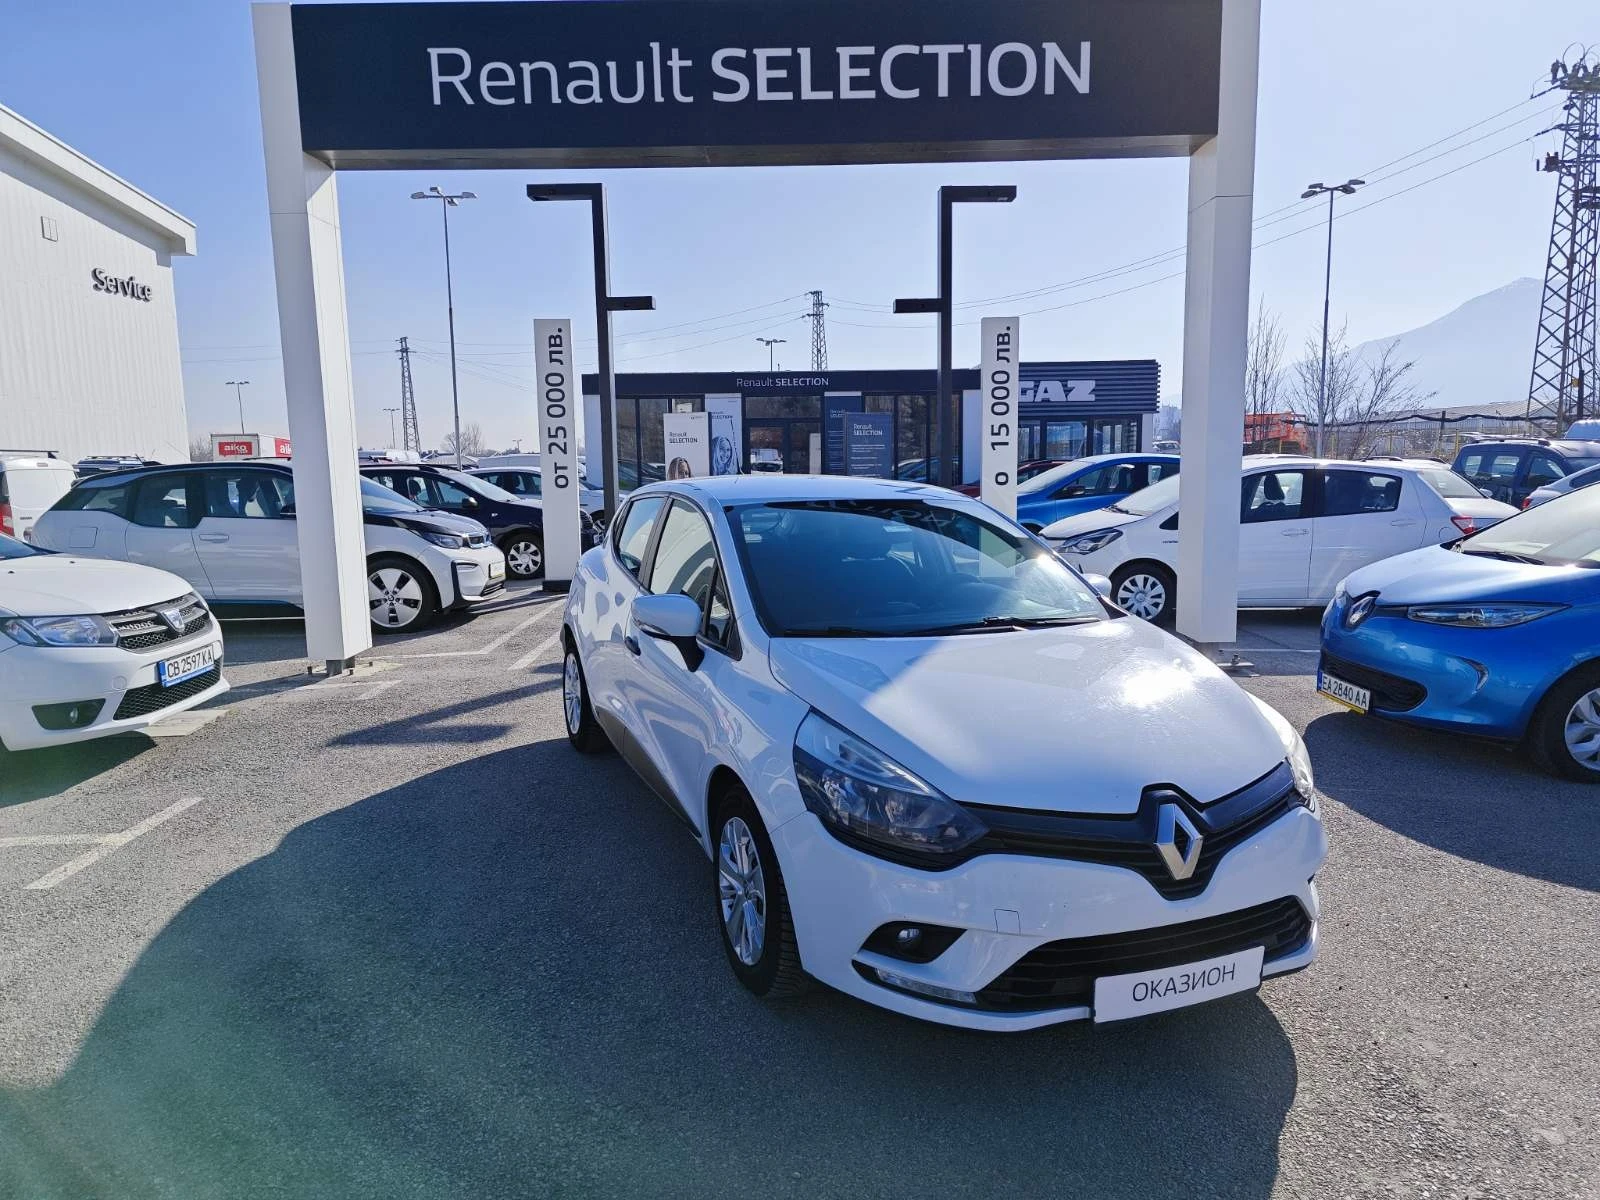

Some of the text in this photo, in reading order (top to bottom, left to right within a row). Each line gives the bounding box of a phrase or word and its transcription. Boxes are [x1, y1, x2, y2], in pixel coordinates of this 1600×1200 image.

[427, 41, 1091, 105] Renault SELECTION
[91, 267, 153, 302] Service
[997, 326, 1011, 363] лв.
[736, 377, 829, 388] Renault SELECTION
[991, 370, 1010, 416] 000
[1018, 380, 1096, 402] GAZ
[545, 328, 569, 489] от 25 000 лв.
[991, 423, 1010, 451] 15
[180, 653, 201, 673] 2597
[1333, 680, 1353, 701] 2840
[1132, 962, 1236, 1002] ОКАЗИОН
